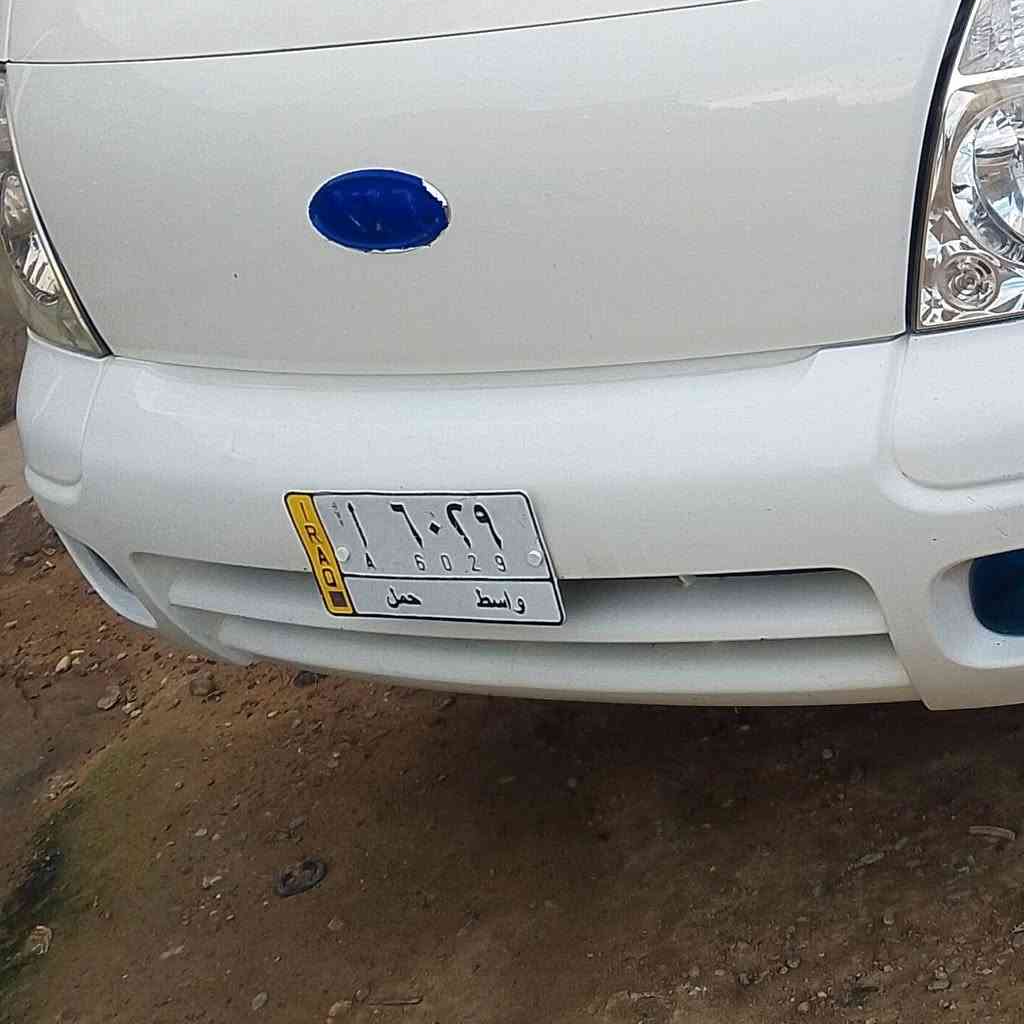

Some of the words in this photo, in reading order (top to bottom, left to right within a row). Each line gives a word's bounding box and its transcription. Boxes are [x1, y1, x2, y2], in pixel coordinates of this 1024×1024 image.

[299, 502, 338, 588] IRAQ
[365, 552, 377, 570] A
[386, 587, 422, 609] حمل
[475, 588, 526, 614] واسط
